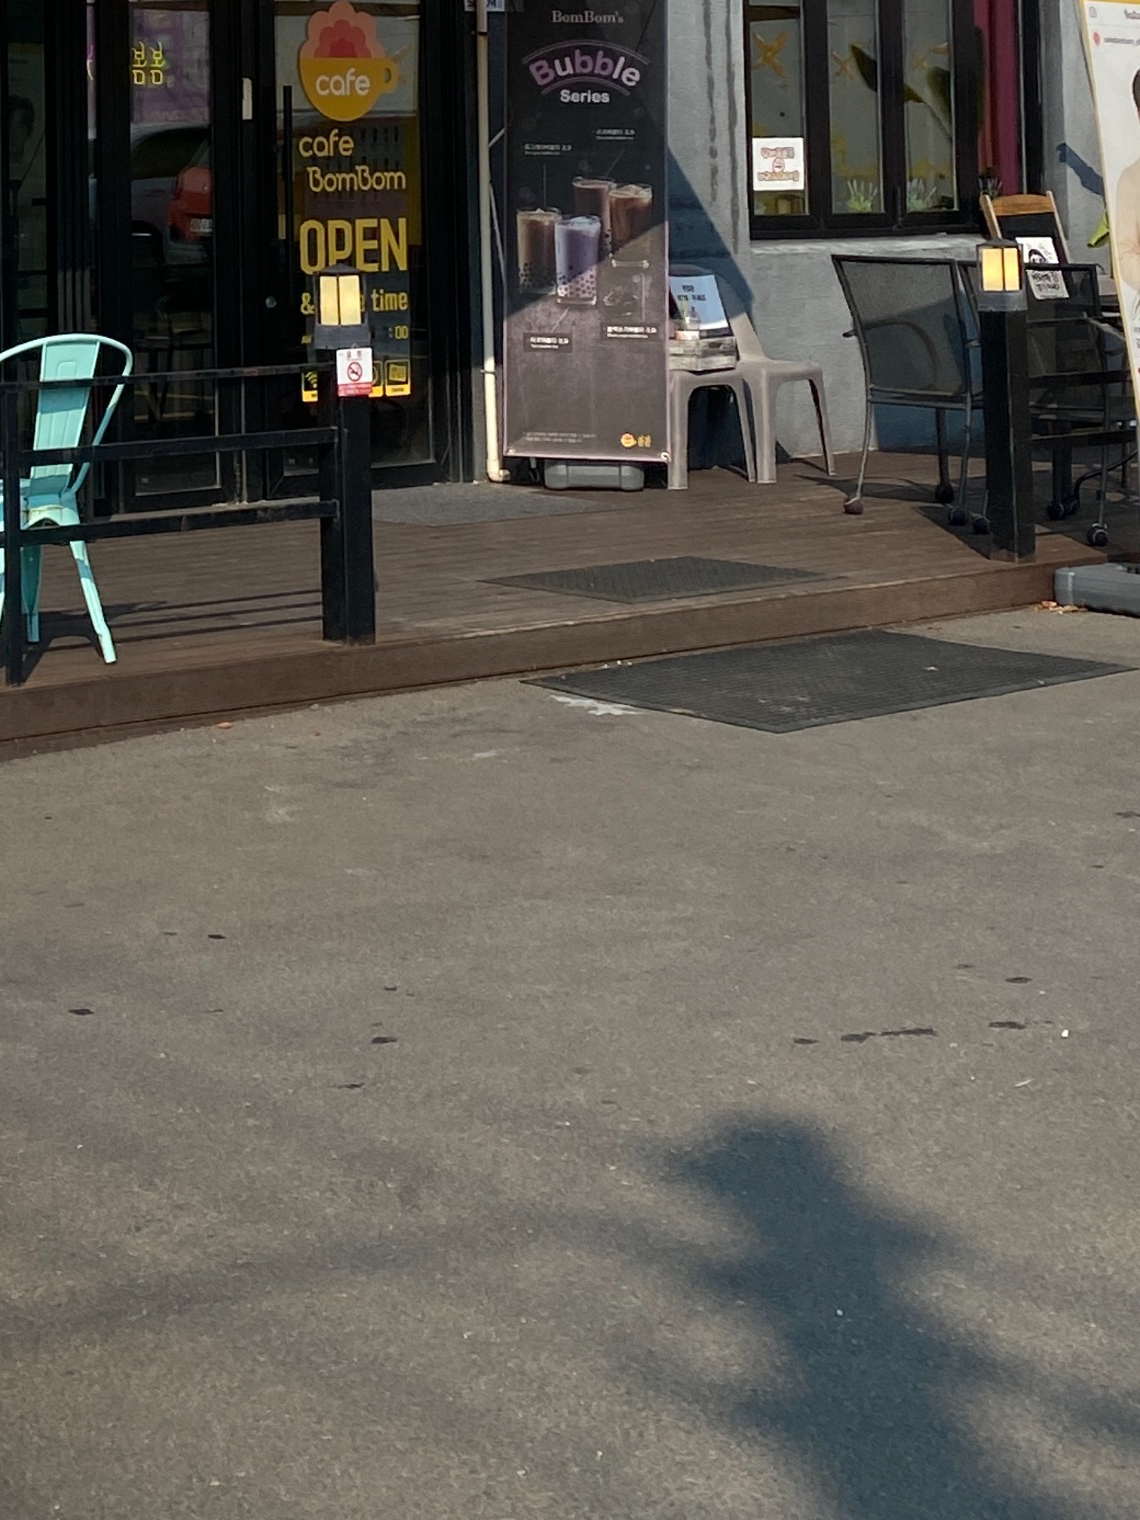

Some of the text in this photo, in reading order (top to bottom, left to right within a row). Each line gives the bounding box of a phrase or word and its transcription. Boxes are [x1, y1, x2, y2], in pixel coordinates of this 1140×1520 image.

[551, 10, 625, 24] BomBom's
[315, 67, 371, 97] cafe
[528, 48, 642, 88] Bubble
[559, 89, 611, 104] Series
[298, 127, 355, 158] cafe
[306, 164, 407, 193] BomBom
[299, 218, 408, 276] OPEN
[370, 288, 409, 312] time
